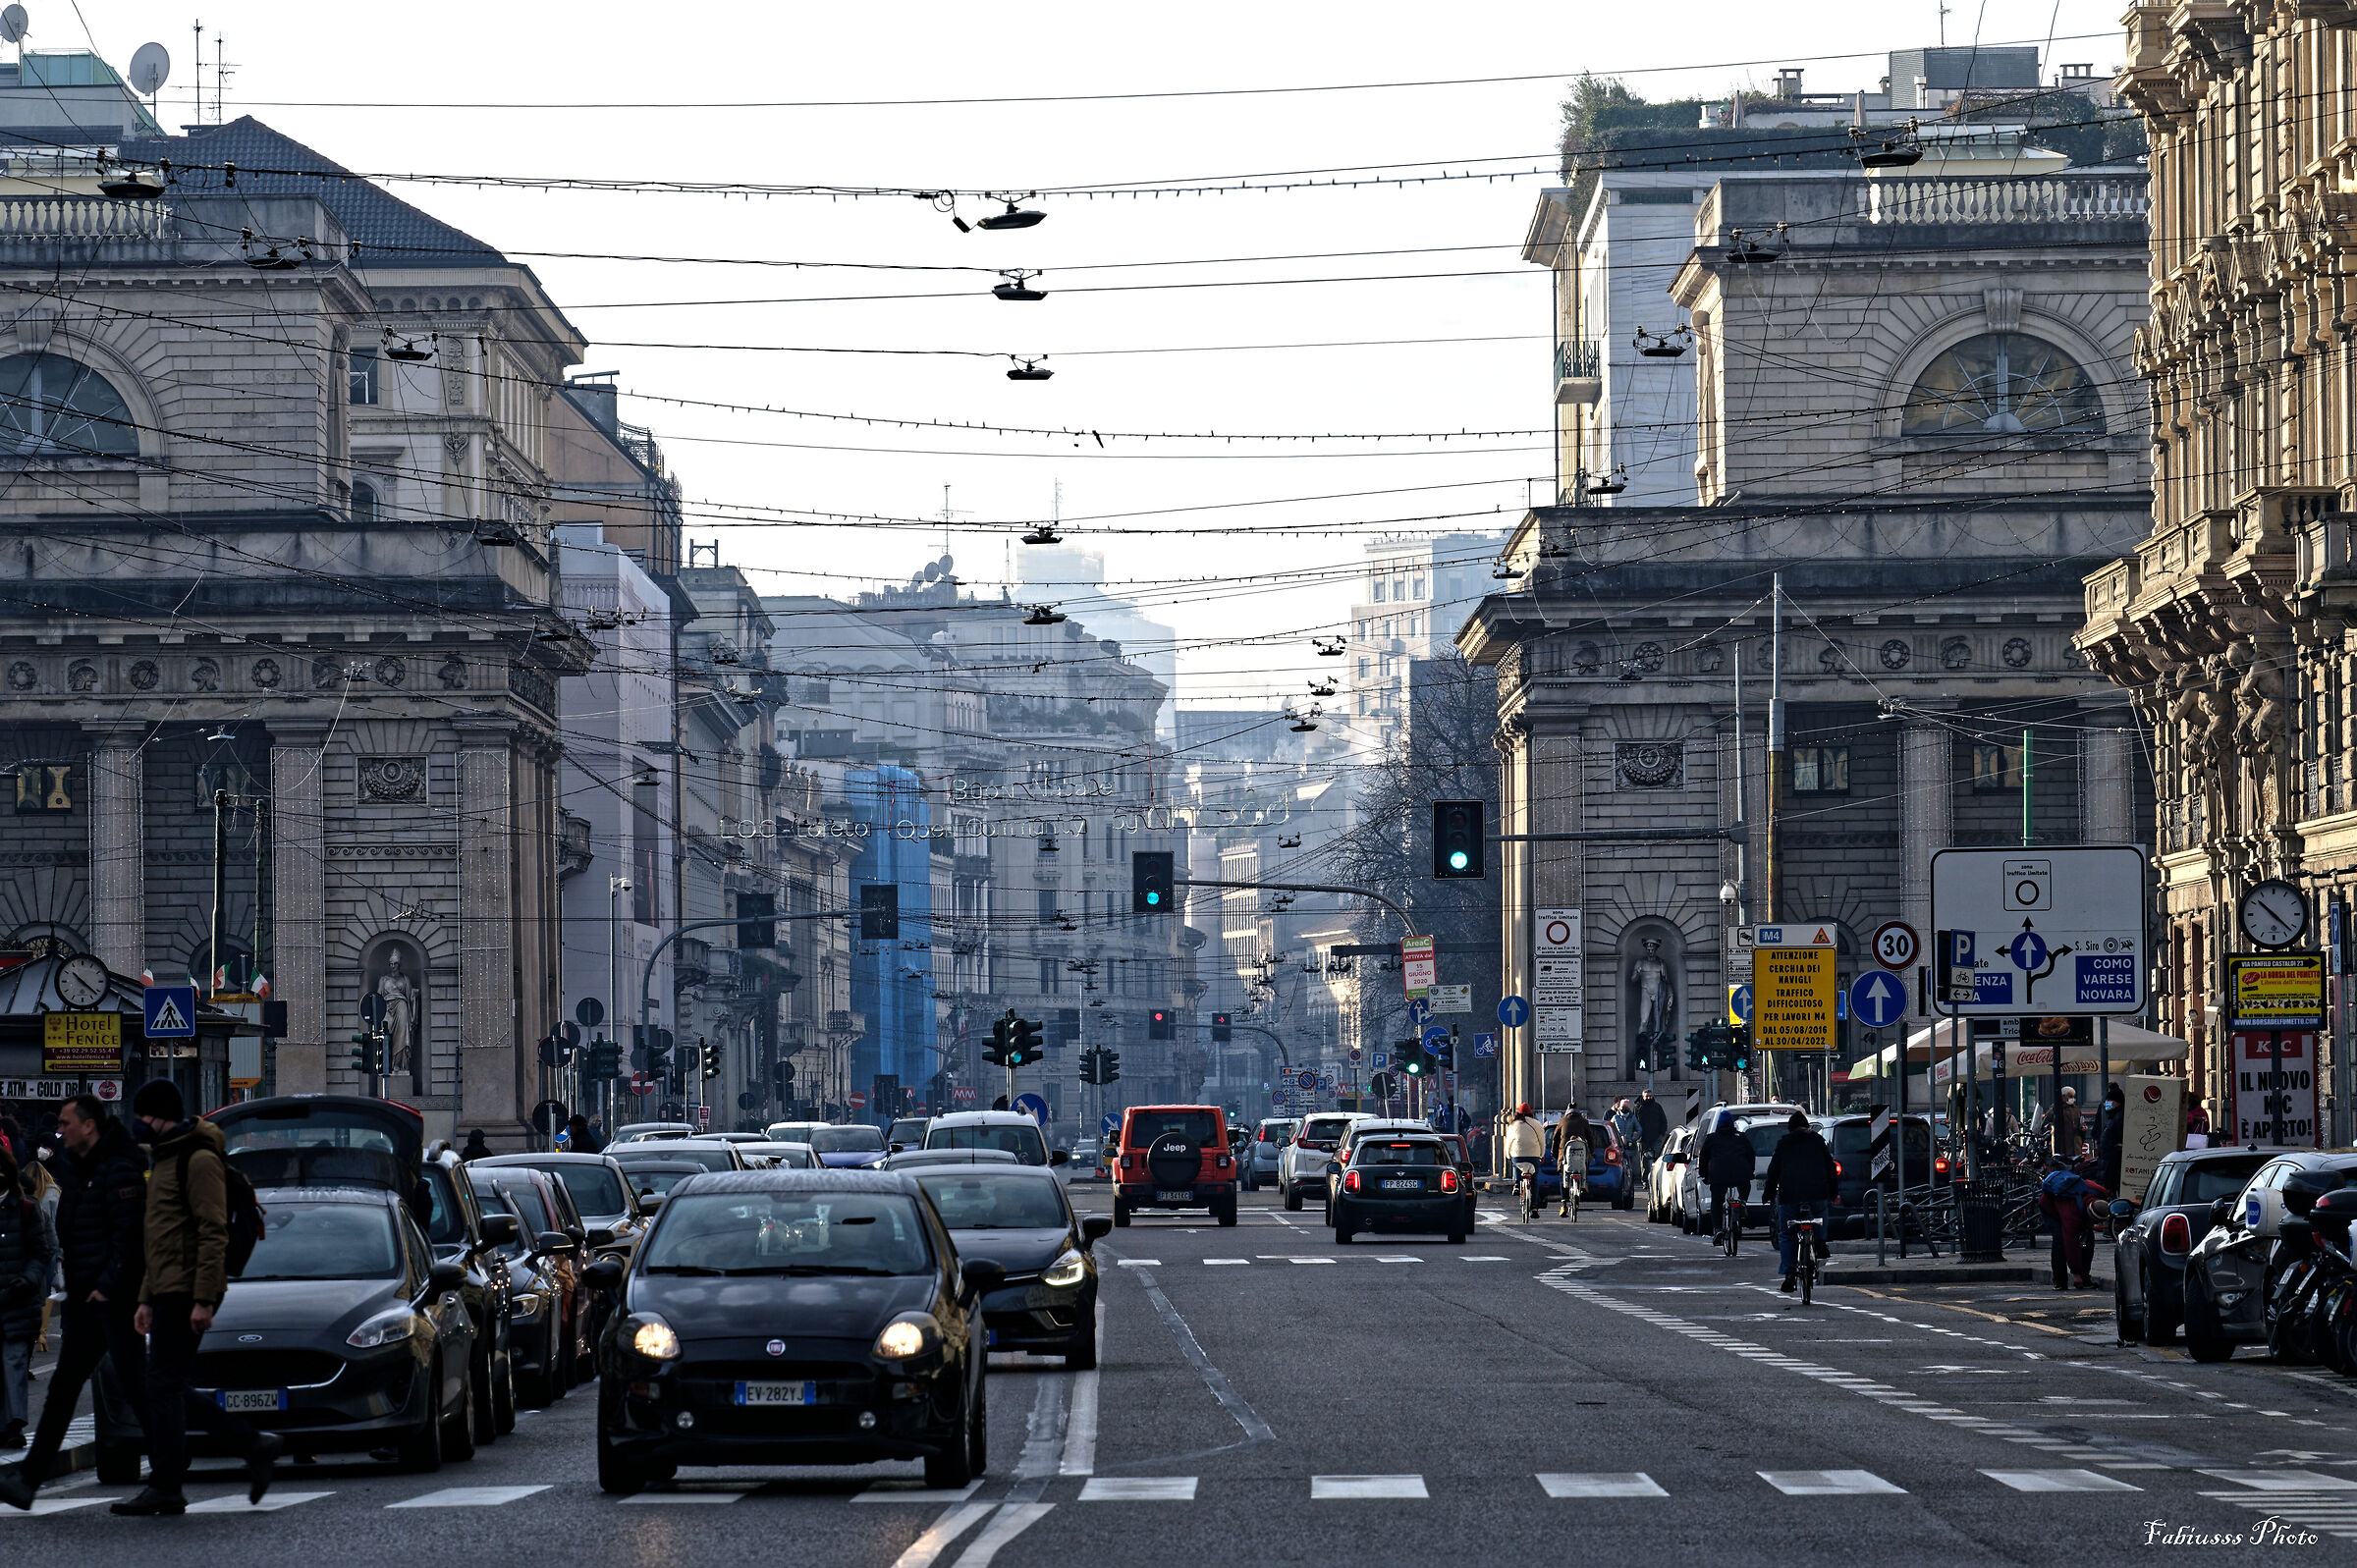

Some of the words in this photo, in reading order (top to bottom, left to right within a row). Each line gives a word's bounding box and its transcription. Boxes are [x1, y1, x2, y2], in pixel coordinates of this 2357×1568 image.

[1764, 932, 1780, 941] M4
[1883, 934, 1909, 957] 30
[1956, 934, 1971, 963] P
[2075, 942, 2082, 951] S.
[2085, 941, 2099, 951] Siro
[1769, 964, 1805, 973] CERCHIA
[1807, 964, 1820, 973] DEI
[1974, 959, 1989, 968] ate
[2093, 959, 2131, 969] COMO
[2083, 974, 2131, 985] VARESE
[2296, 970, 2320, 979] FUMETTO
[1974, 976, 2007, 987] ENZA
[2080, 990, 2131, 1000] NOVARA
[1764, 1012, 1779, 1021] PER
[1781, 1012, 1811, 1021] LAVORI
[1814, 1012, 1826, 1021] M4
[1777, 1037, 1826, 1046] 30/04/2022
[2256, 1040, 2293, 1053] KC
[2240, 1072, 2254, 1092] IL
[2257, 1070, 2310, 1091] NOVO
[7, 1081, 27, 1097] ATM
[37, 1081, 61, 1097] COLD
[65, 1082, 94, 1097] DRK
[2264, 1095, 2292, 1115] KC
[2241, 1118, 2250, 1139] È
[2253, 1119, 2313, 1139] APRTO!
[1163, 1143, 1186, 1153] Jeep
[747, 1386, 762, 1401] EV
[766, 1386, 803, 1401] 282YJ
